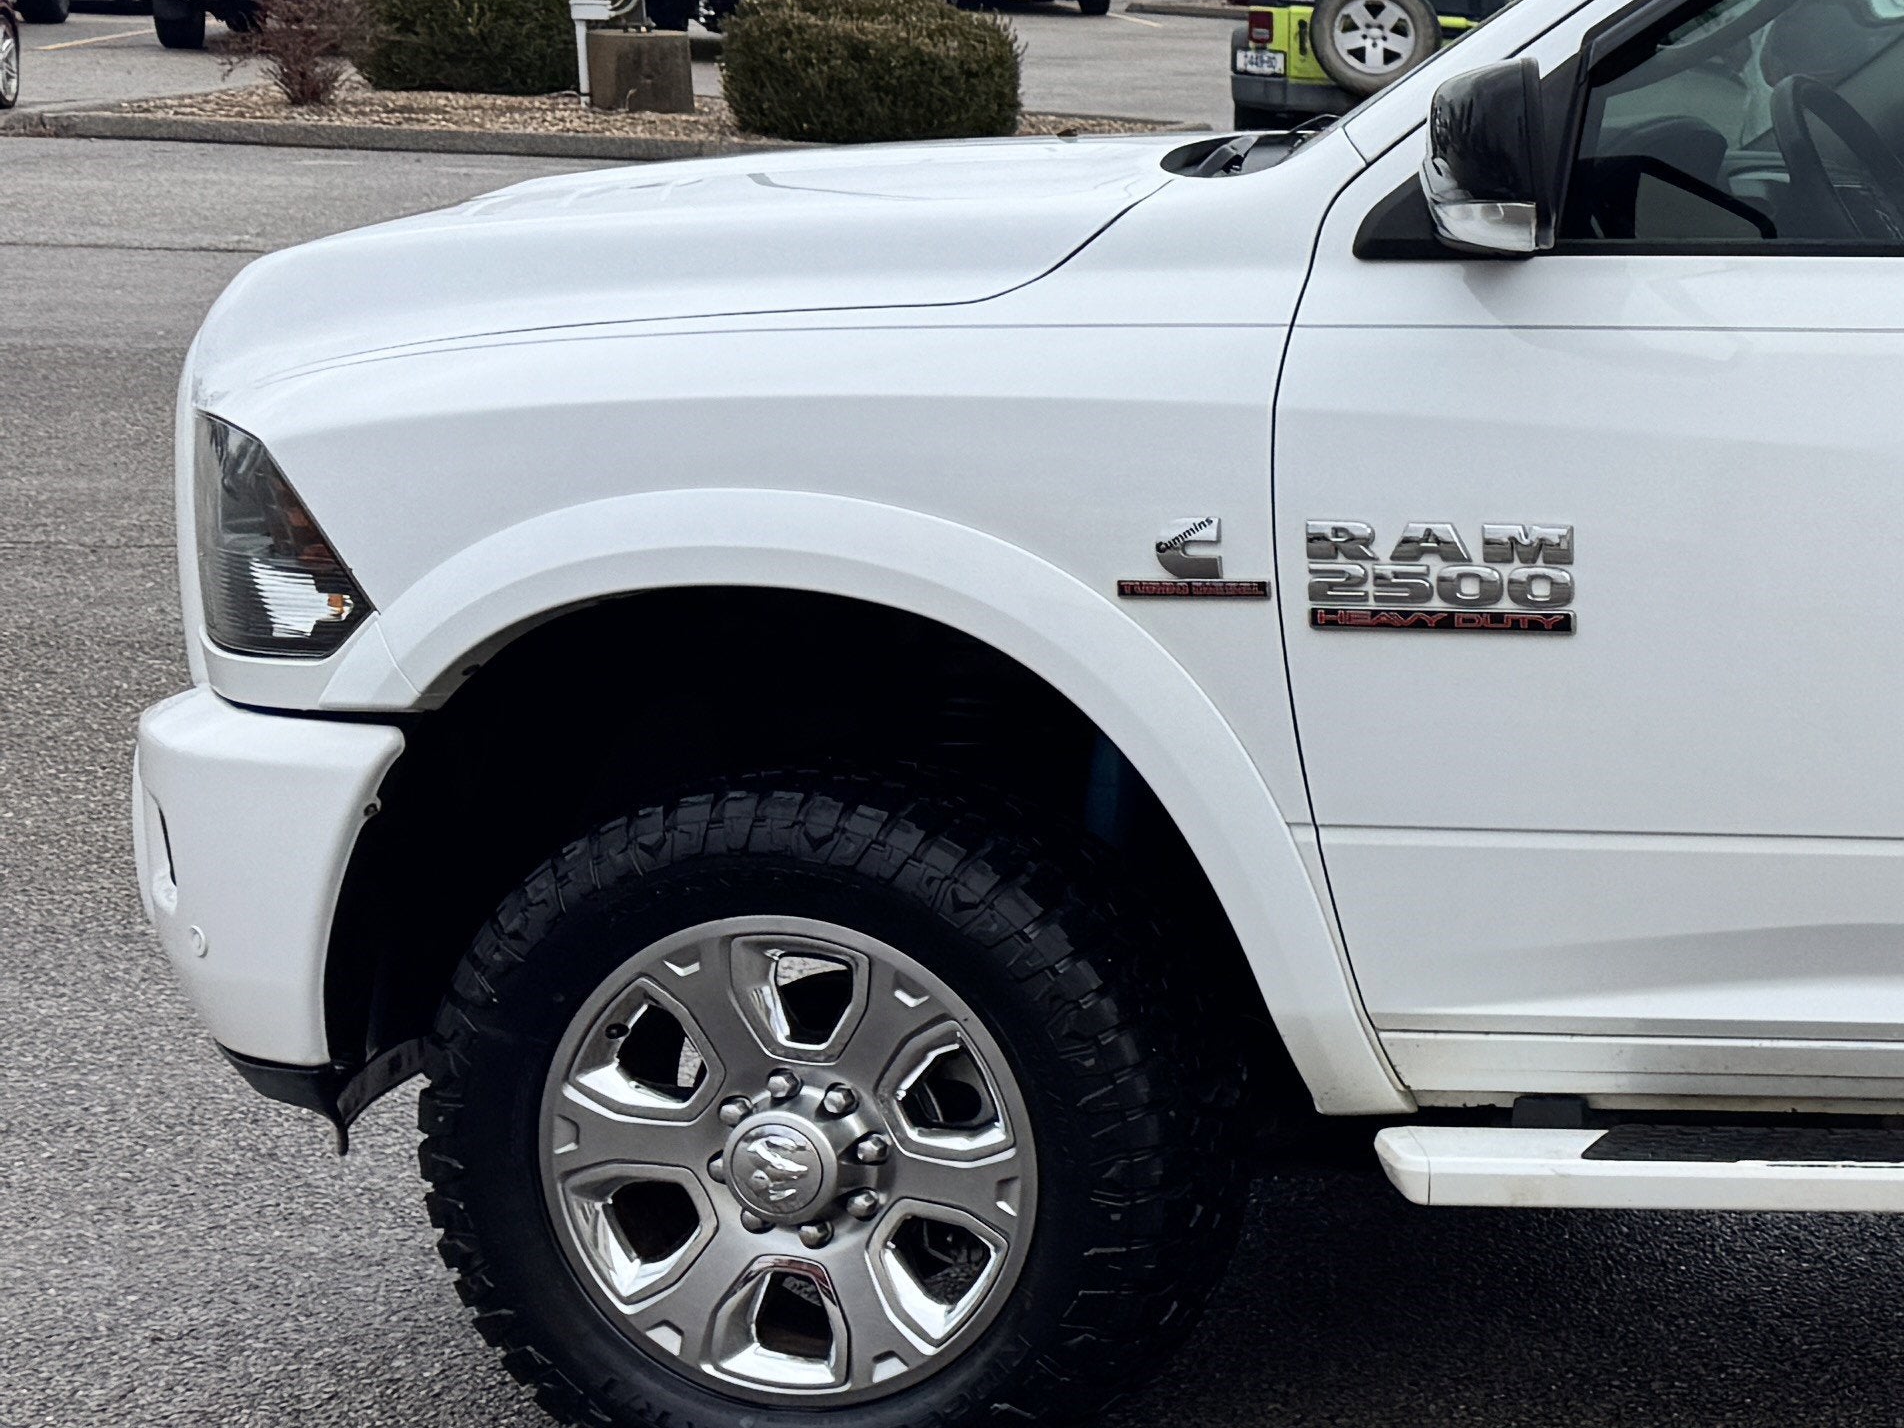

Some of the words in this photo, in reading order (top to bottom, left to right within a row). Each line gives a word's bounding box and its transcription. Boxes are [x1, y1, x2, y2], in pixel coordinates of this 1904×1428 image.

[1155, 516, 1214, 554] Cummins
[1305, 520, 1575, 565] RAM
[1307, 561, 1575, 609] 2500
[1316, 609, 1449, 628] HEAVY
[1454, 612, 1566, 630] DUTY
